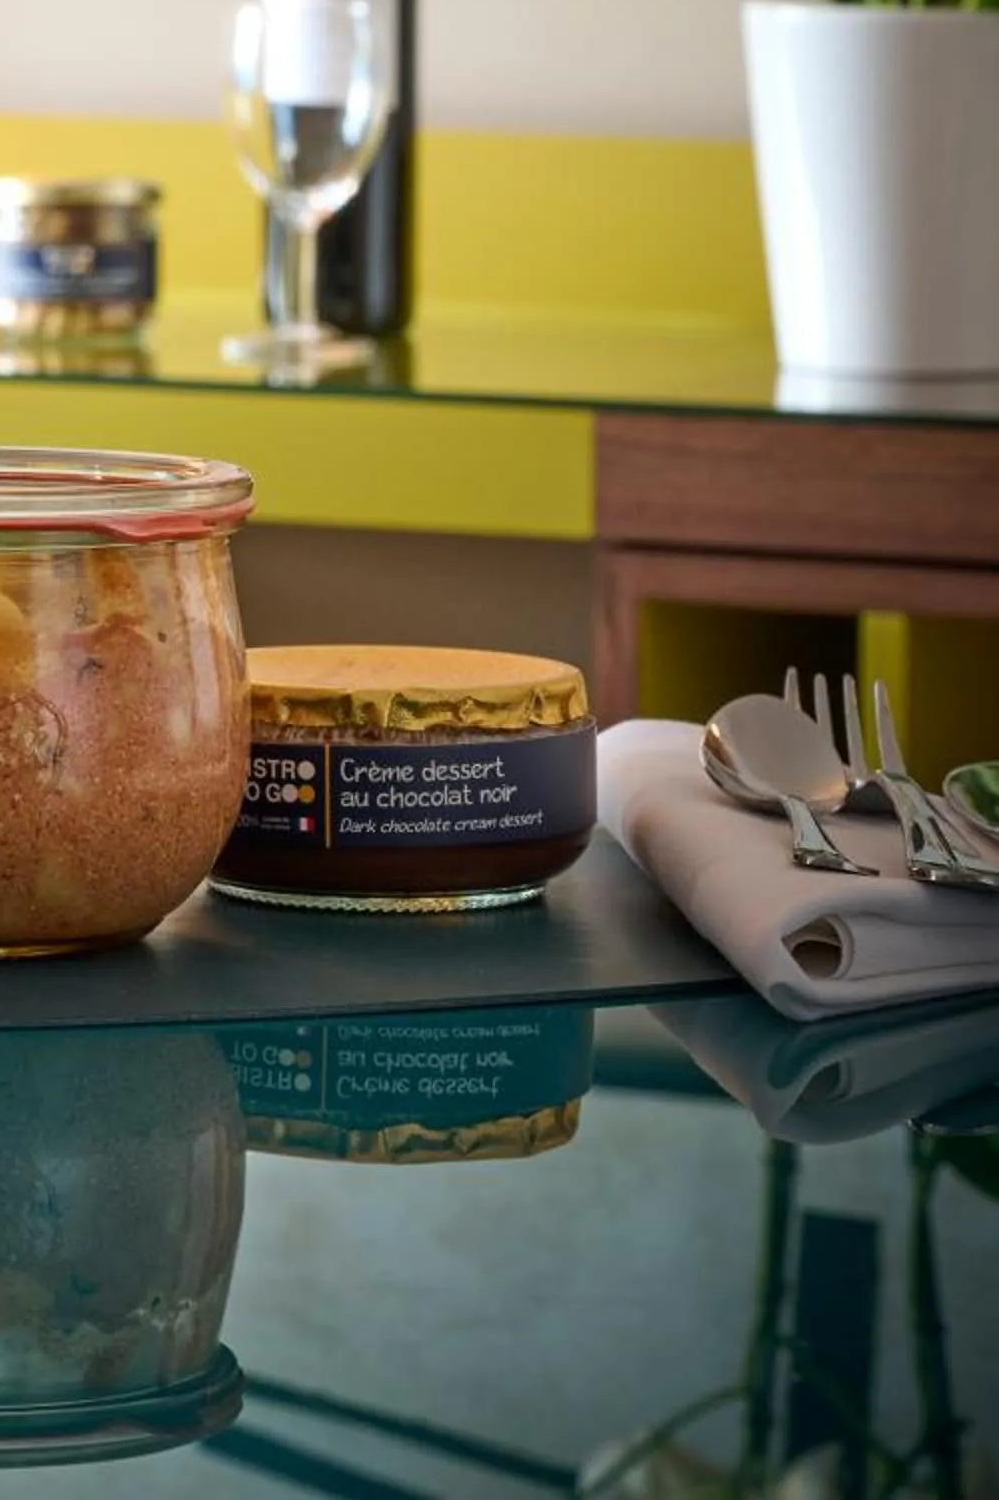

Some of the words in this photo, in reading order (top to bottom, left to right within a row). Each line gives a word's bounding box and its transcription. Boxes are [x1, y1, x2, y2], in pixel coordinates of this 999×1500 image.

[339, 758, 415, 783] Crème
[421, 756, 506, 782] dessert
[340, 790, 370, 808] au
[376, 784, 474, 808] chocolat
[480, 783, 518, 804] noir
[339, 817, 376, 834] Dark
[380, 818, 451, 834] chocolate
[454, 817, 497, 832] cream
[499, 808, 544, 829] dessert
